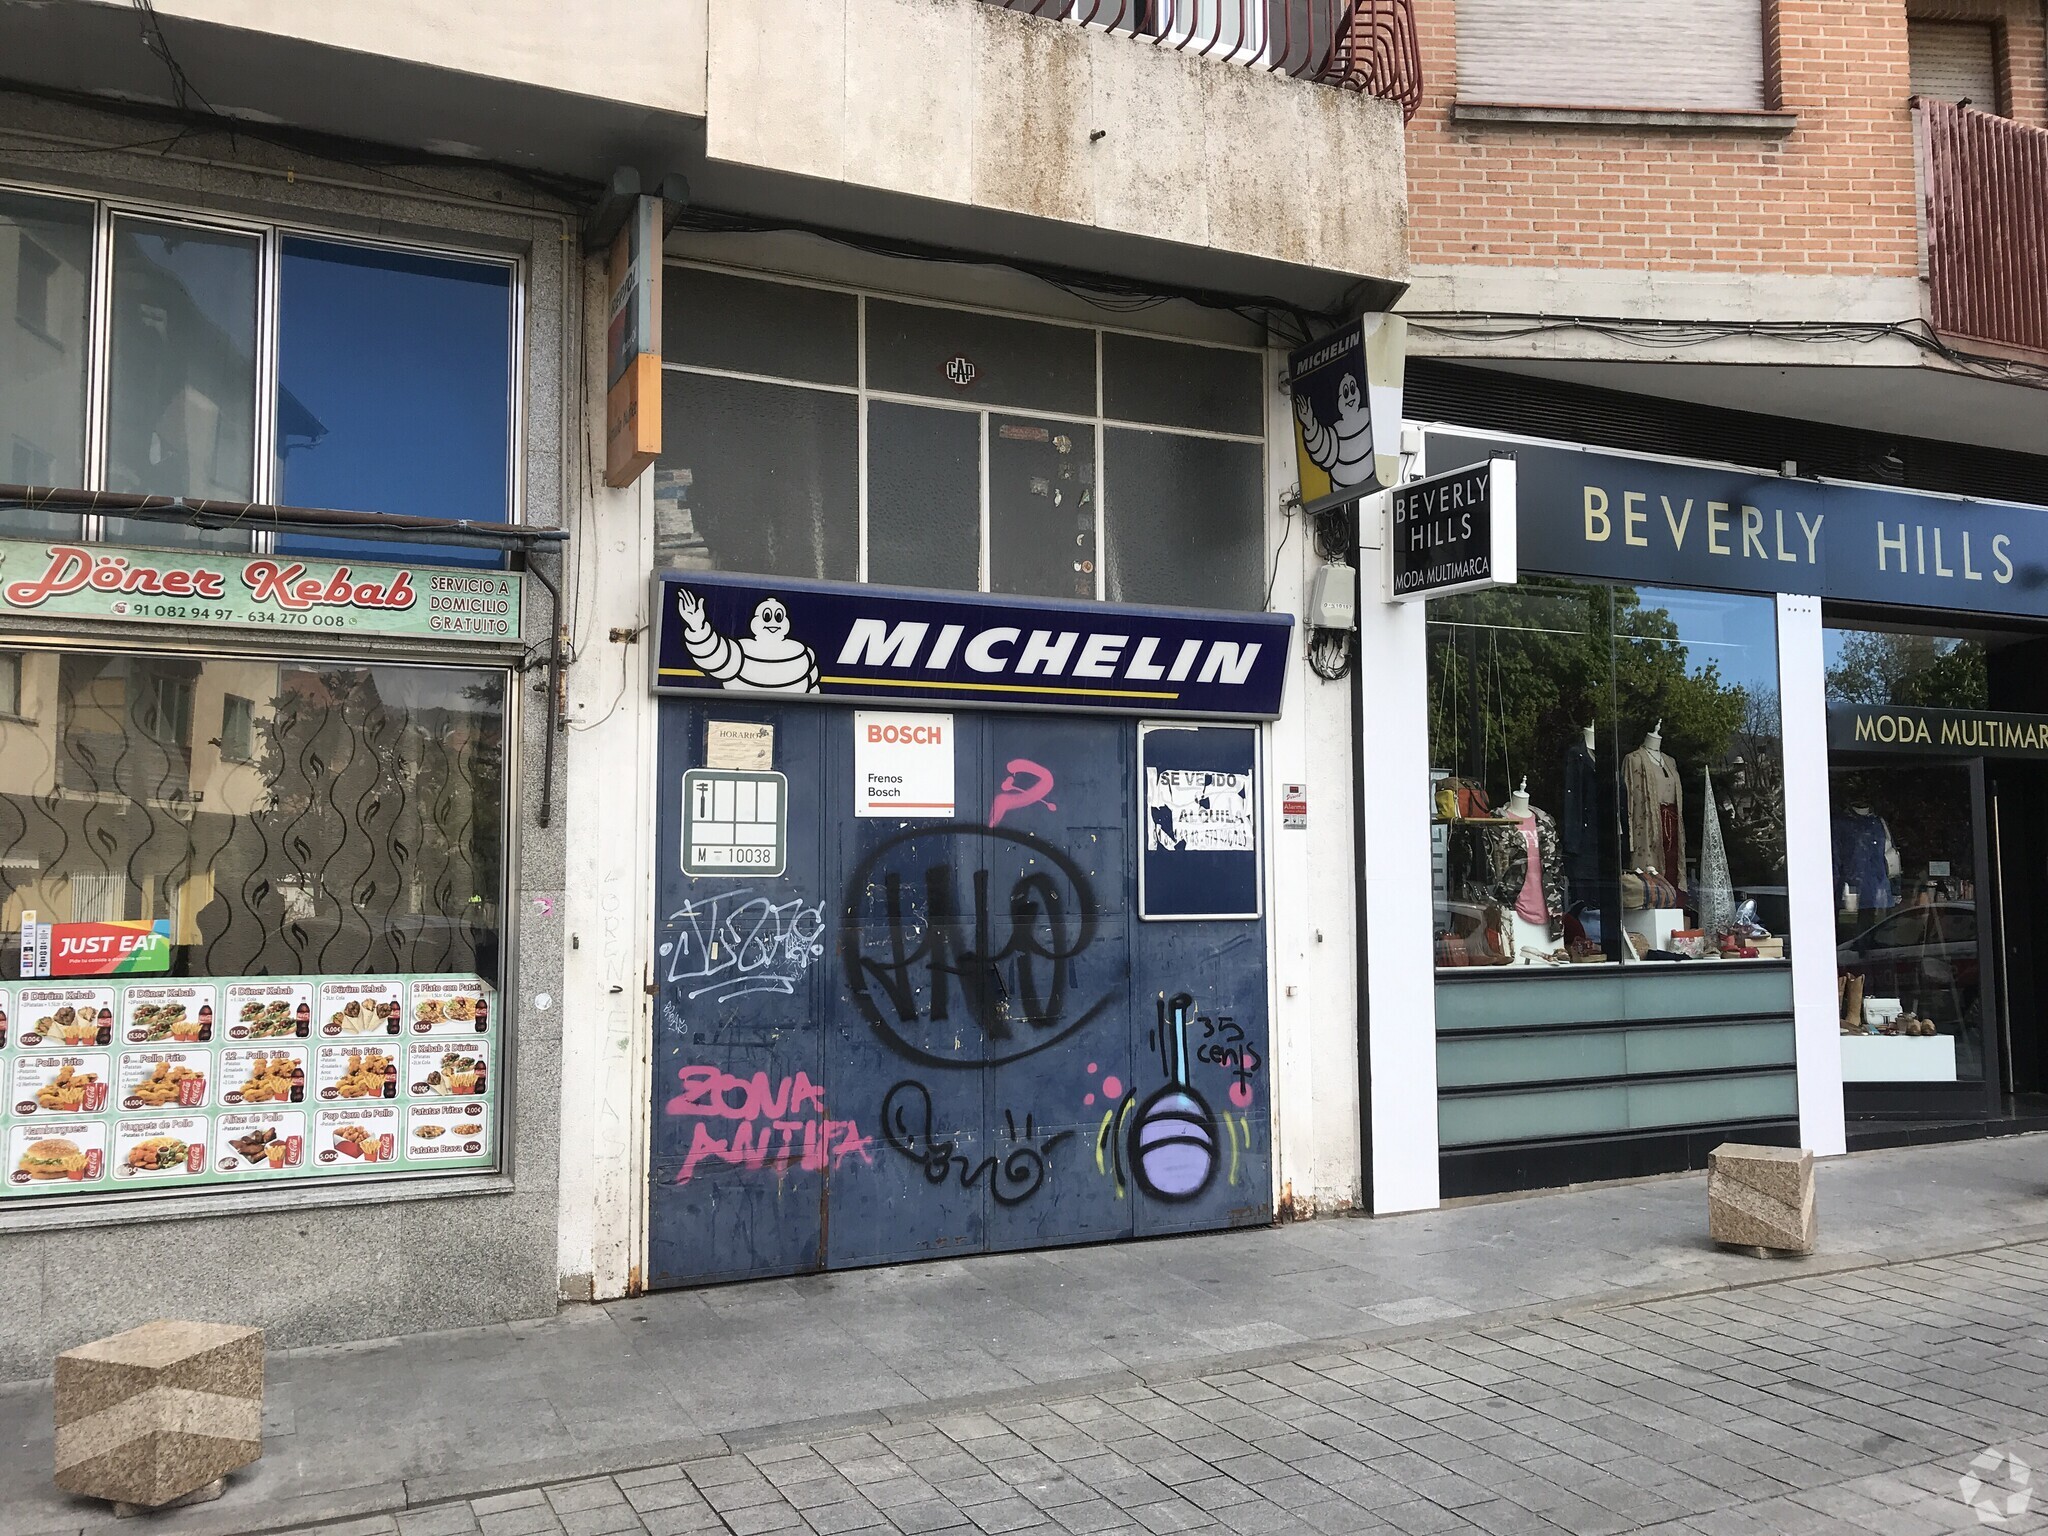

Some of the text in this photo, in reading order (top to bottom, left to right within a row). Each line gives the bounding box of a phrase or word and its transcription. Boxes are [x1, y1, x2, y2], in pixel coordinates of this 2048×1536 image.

[1296, 331, 1361, 376] MICHELIN
[947, 358, 975, 384] CAP
[1396, 474, 1489, 523] BEVERLY
[1411, 512, 1472, 551] HILLS
[1583, 485, 2014, 584] BEVERLY HILLS
[5, 547, 416, 610] Döner Kebab
[1395, 556, 1490, 590] MODA MULTIMARCA
[430, 576, 510, 595] SERVICIO A
[430, 596, 509, 614] DOMICILIO
[134, 604, 149, 615] 91
[154, 605, 186, 618] 082
[191, 608, 209, 619] 94
[215, 609, 232, 620] 97
[248, 611, 275, 623] 634
[280, 613, 307, 625] 270
[312, 614, 344, 627] 008
[430, 615, 508, 633] GRATUITO
[837, 618, 1263, 685] MICHELIN
[868, 724, 941, 744] BOSCH
[1855, 715, 1932, 744] MODA
[868, 773, 903, 783] Frenos
[1160, 772, 1180, 786] SE
[868, 786, 901, 797] Bosch
[698, 849, 771, 864] M 10038
[58, 934, 162, 957] JUST EAT
[128, 988, 196, 998] 3 Döner Kebab
[238, 987, 265, 995] Döner
[266, 986, 294, 995] Kebab
[323, 984, 387, 993] 4 Dürüm Kebab
[413, 984, 420, 992] 2
[421, 983, 441, 992] Plato
[22, 992, 28, 1000] 3
[65, 990, 95, 999] Kebab
[1197, 1017, 1244, 1042] 35
[225, 1050, 290, 1060] 12 Pollo Frito
[321, 1047, 383, 1057] 16 Pollo Frito
[418, 1044, 443, 1053] Kebab
[18, 1057, 84, 1068] 6 Pollo Frito
[123, 1053, 186, 1064] 9 Pollo Frito
[666, 1065, 826, 1120] ZONA
[322, 1109, 393, 1121] Pop Corn de Pollo
[411, 1106, 463, 1115] Patatas Fritas
[223, 1112, 283, 1124] Alitas de Pollo
[23, 1125, 88, 1136] Hamburguesa
[120, 1119, 193, 1132] Nuggets de Pollo
[410, 1145, 462, 1154] Patatas Brava
[675, 1119, 873, 1186] ANTIFA
